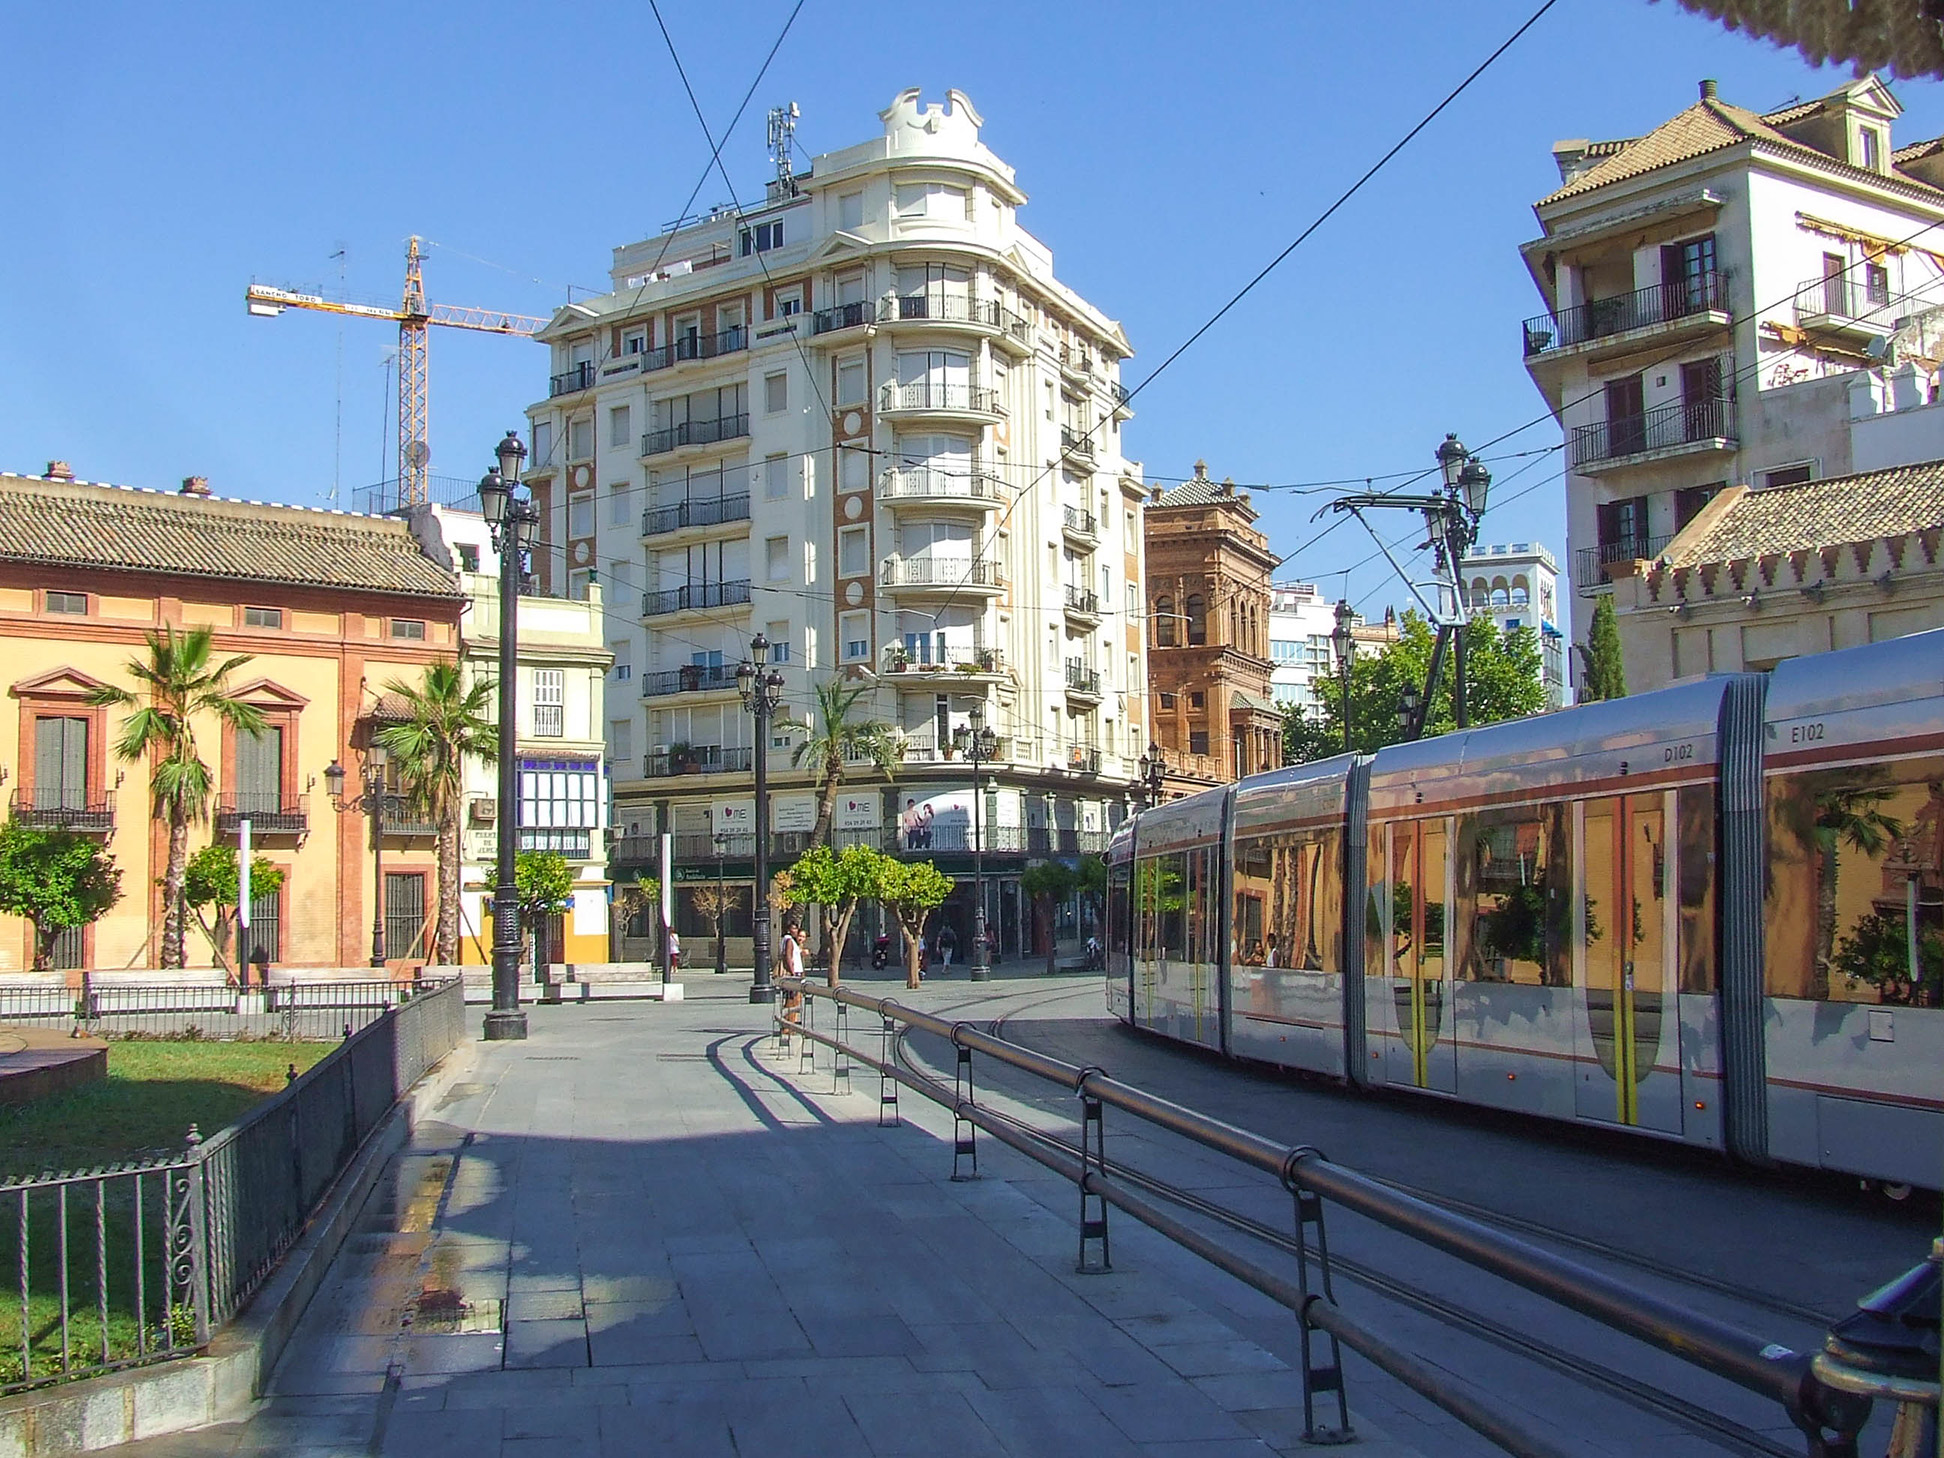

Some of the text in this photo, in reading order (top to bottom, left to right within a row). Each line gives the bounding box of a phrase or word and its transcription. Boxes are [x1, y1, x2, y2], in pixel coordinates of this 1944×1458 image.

[255, 289, 287, 298] SANCHO
[1792, 723, 1824, 743] E102
[1665, 744, 1692, 762] D102
